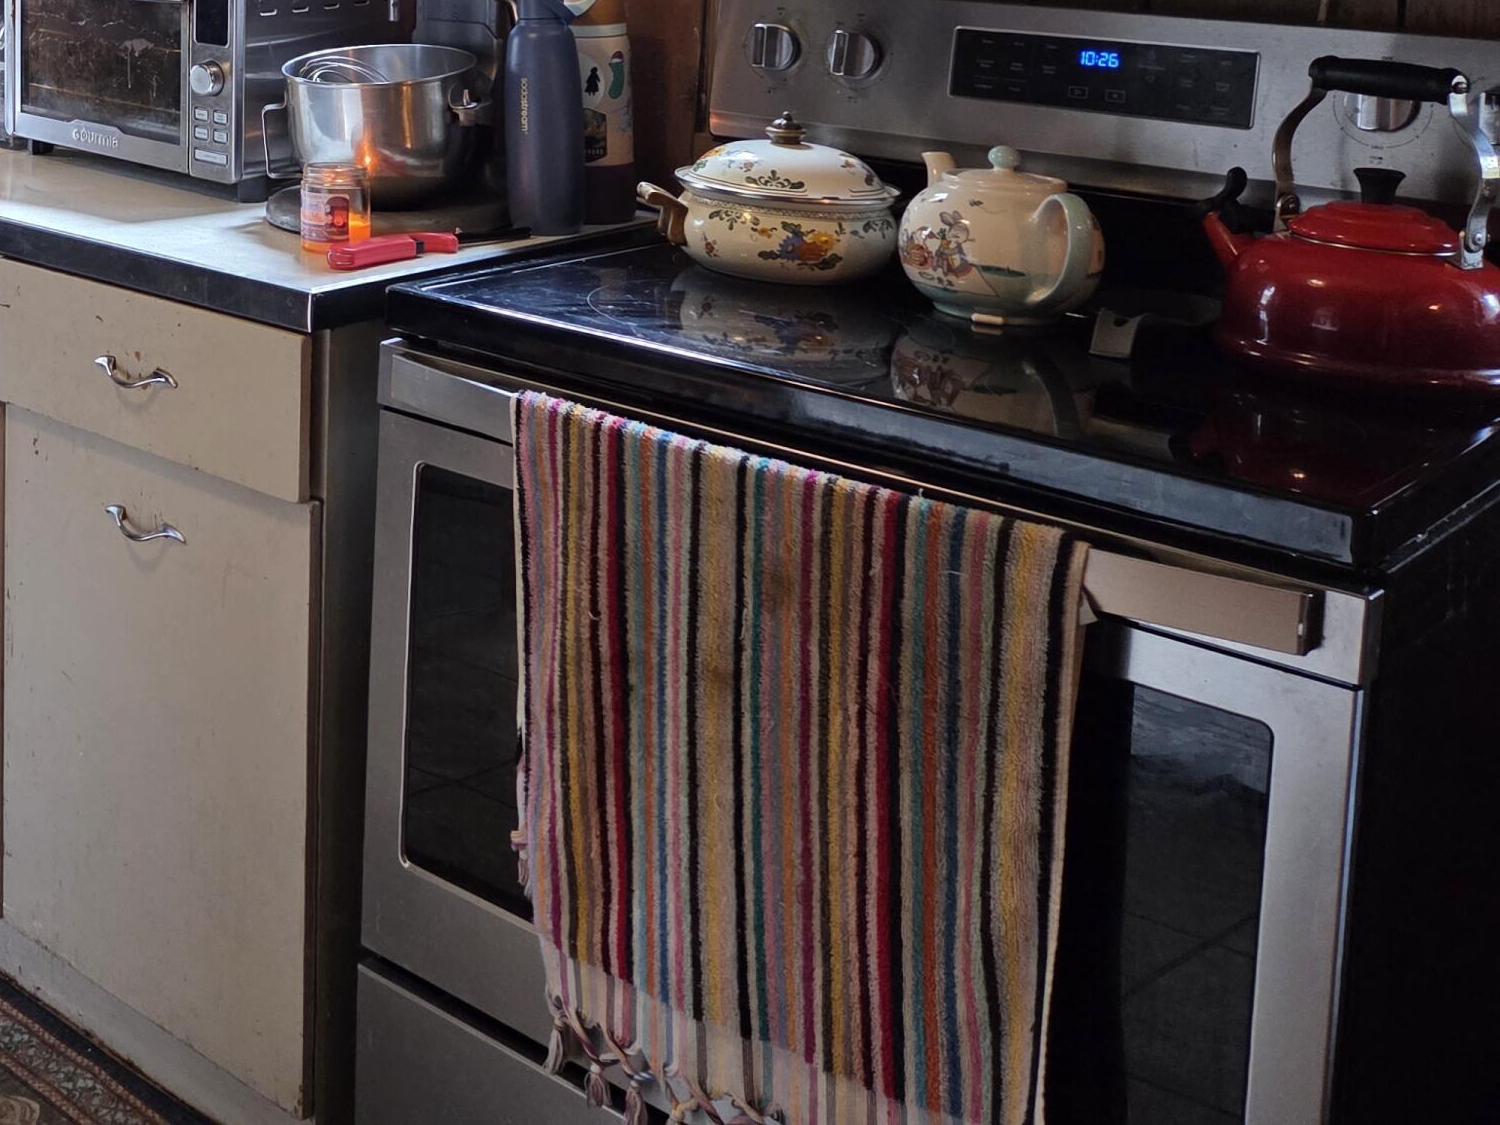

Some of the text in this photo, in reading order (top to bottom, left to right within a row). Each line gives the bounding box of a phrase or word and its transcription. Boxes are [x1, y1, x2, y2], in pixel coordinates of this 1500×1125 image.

[1080, 50, 1120, 68] 10:26
[520, 77, 528, 134] sodastream
[71, 126, 119, 148] Gourmia
